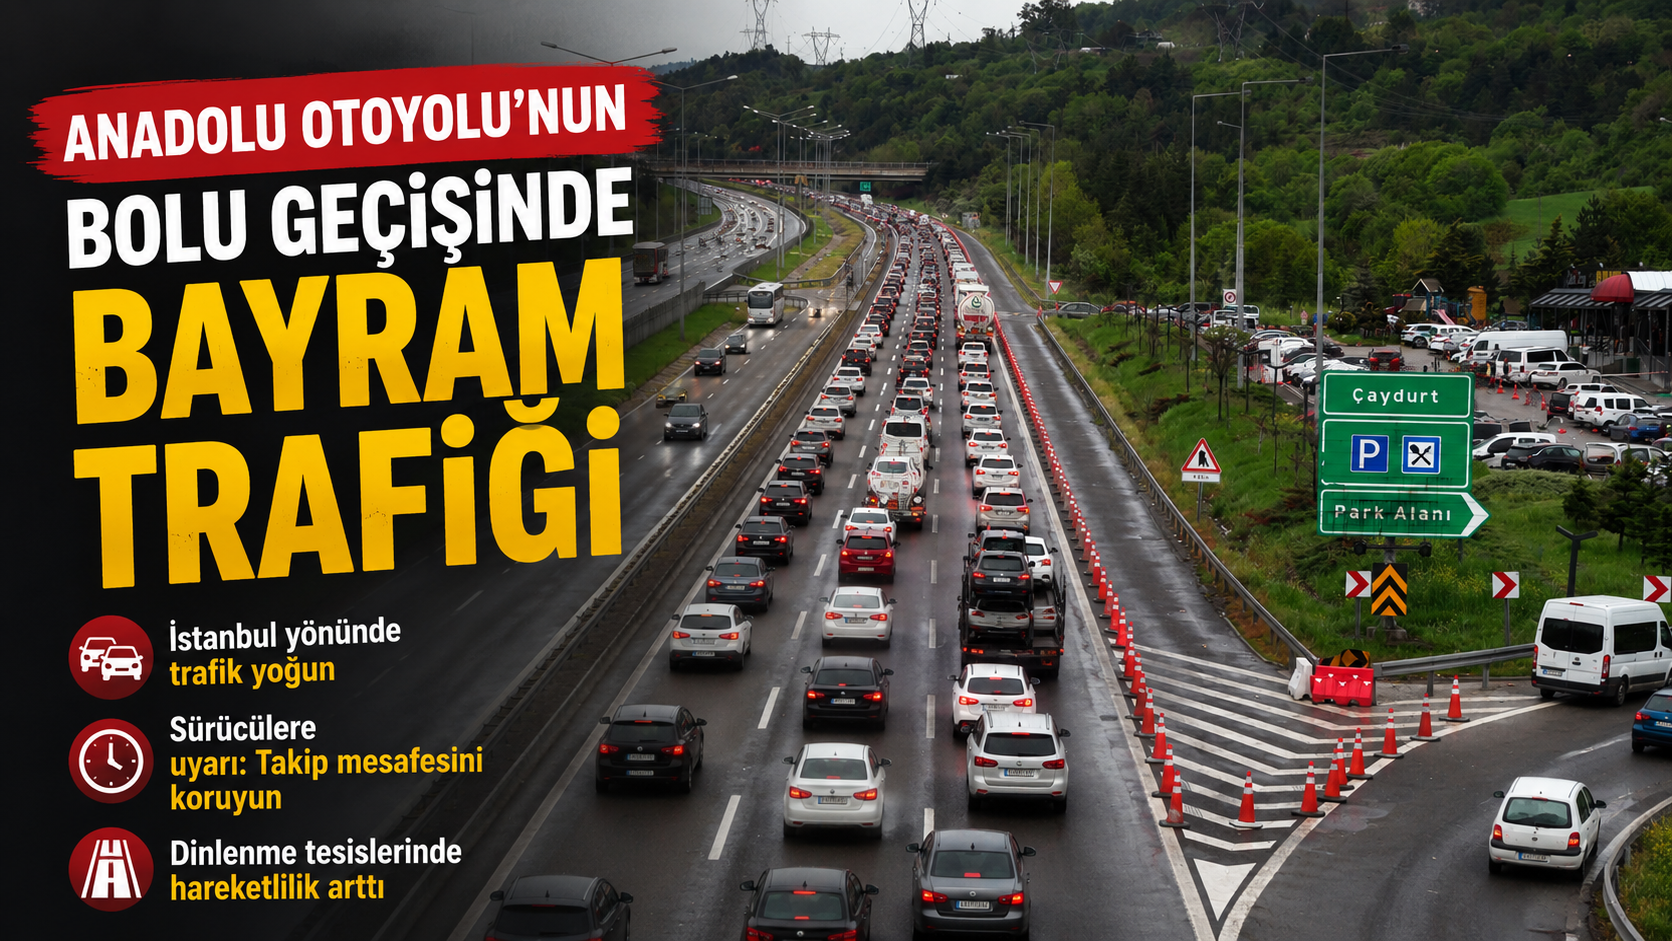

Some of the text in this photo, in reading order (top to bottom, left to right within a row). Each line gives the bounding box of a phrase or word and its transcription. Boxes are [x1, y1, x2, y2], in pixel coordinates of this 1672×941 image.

[1352, 387, 1439, 407] Çaydurt
[1334, 504, 1452, 522] Park Alanı
